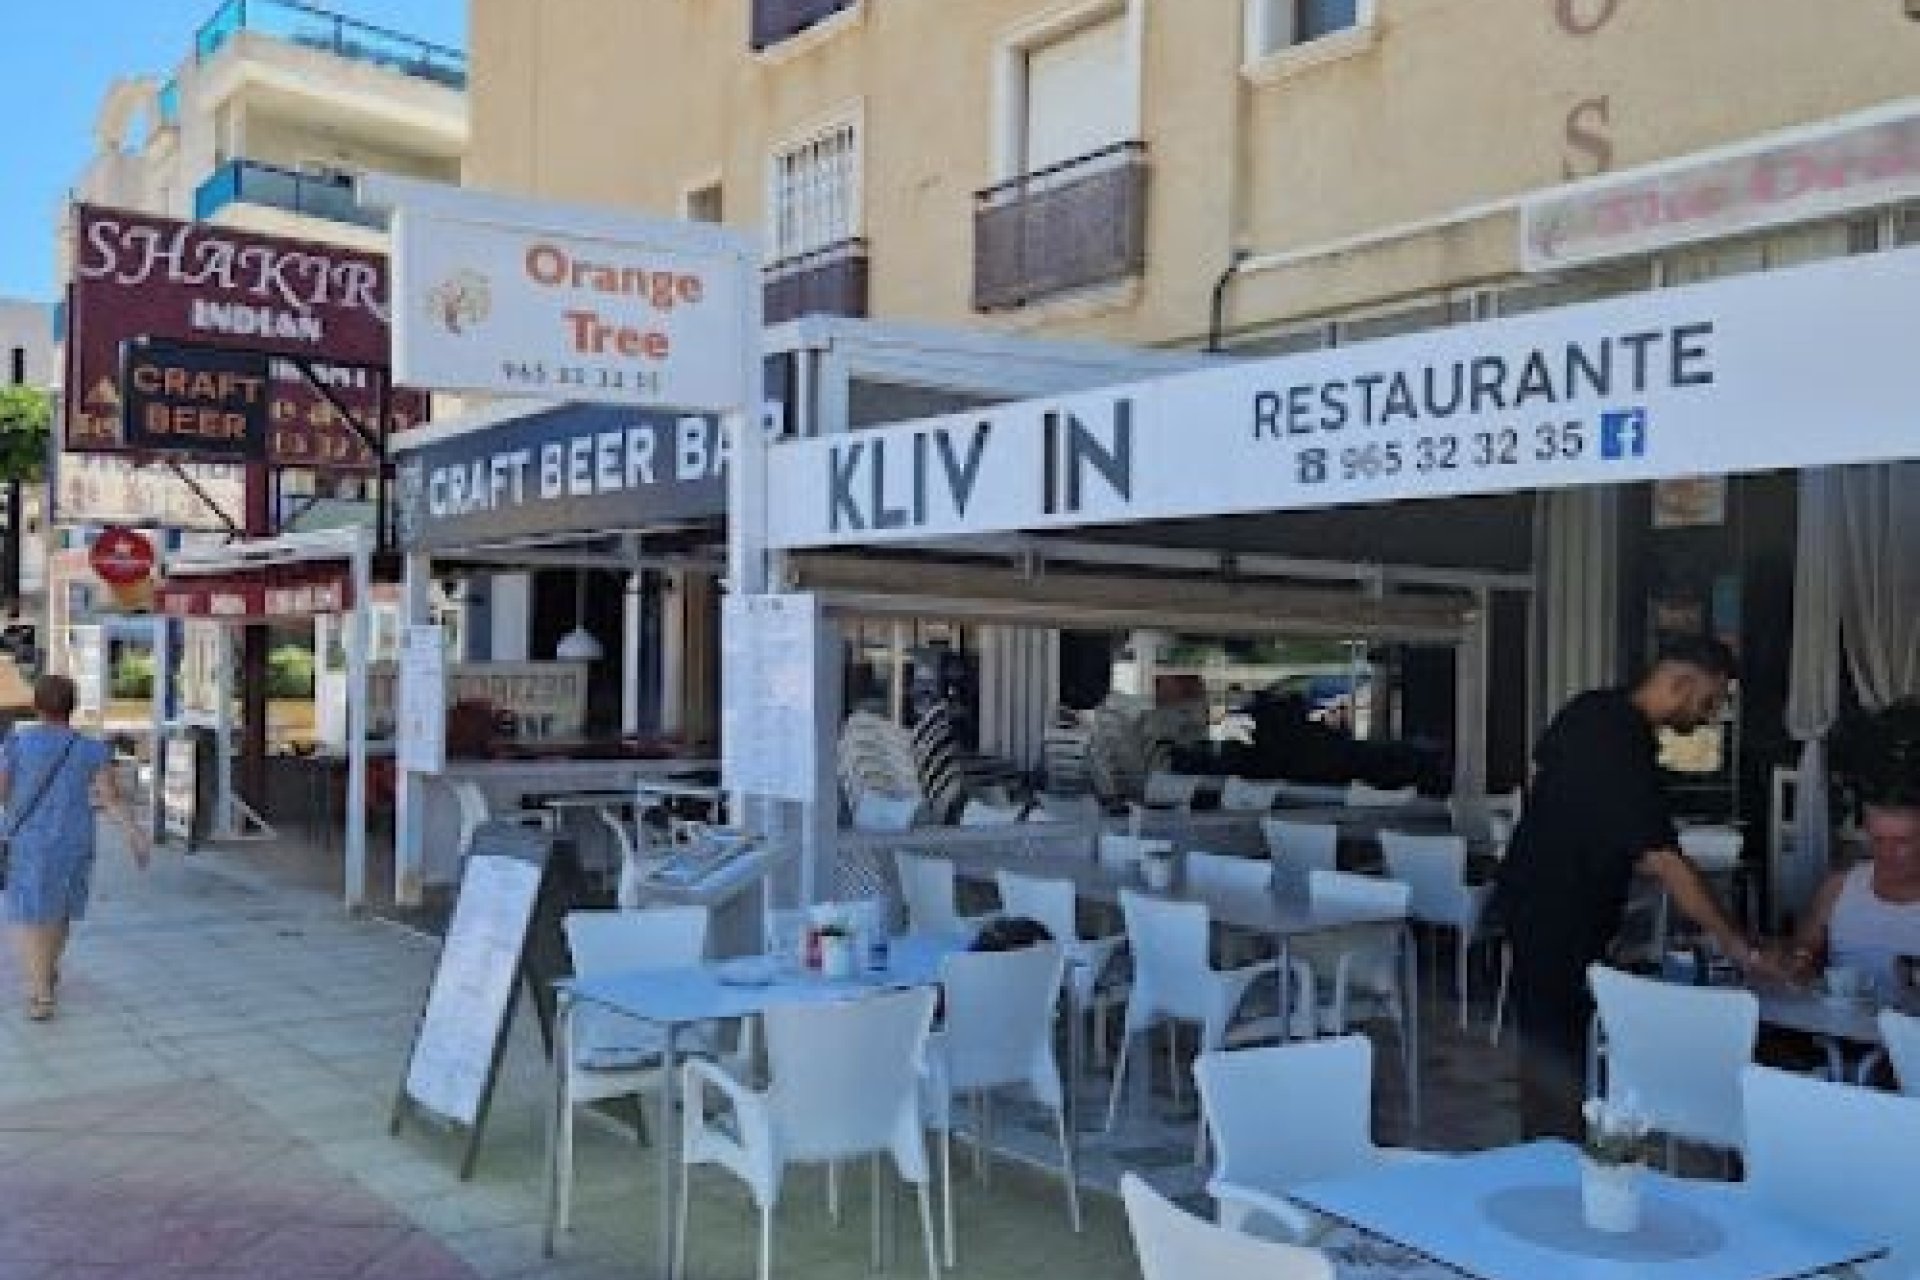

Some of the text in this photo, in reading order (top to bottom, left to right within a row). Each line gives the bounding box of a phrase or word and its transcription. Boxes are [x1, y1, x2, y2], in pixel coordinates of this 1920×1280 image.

[79, 220, 392, 324] SHAKIR
[524, 243, 704, 308] Orange
[190, 298, 323, 342] INDIAN
[562, 309, 670, 359] Tree
[133, 362, 262, 404] CRAFT
[1252, 323, 1714, 440] RESTAURANTE
[145, 402, 247, 440] BEER
[1340, 442, 1403, 480] 965
[1415, 435, 1459, 474] 32
[1473, 428, 1519, 465] 32
[1534, 420, 1584, 460] 35
[428, 447, 532, 516] CRAFT
[540, 427, 655, 499] BEER
[828, 399, 1133, 533] KLIV IN
